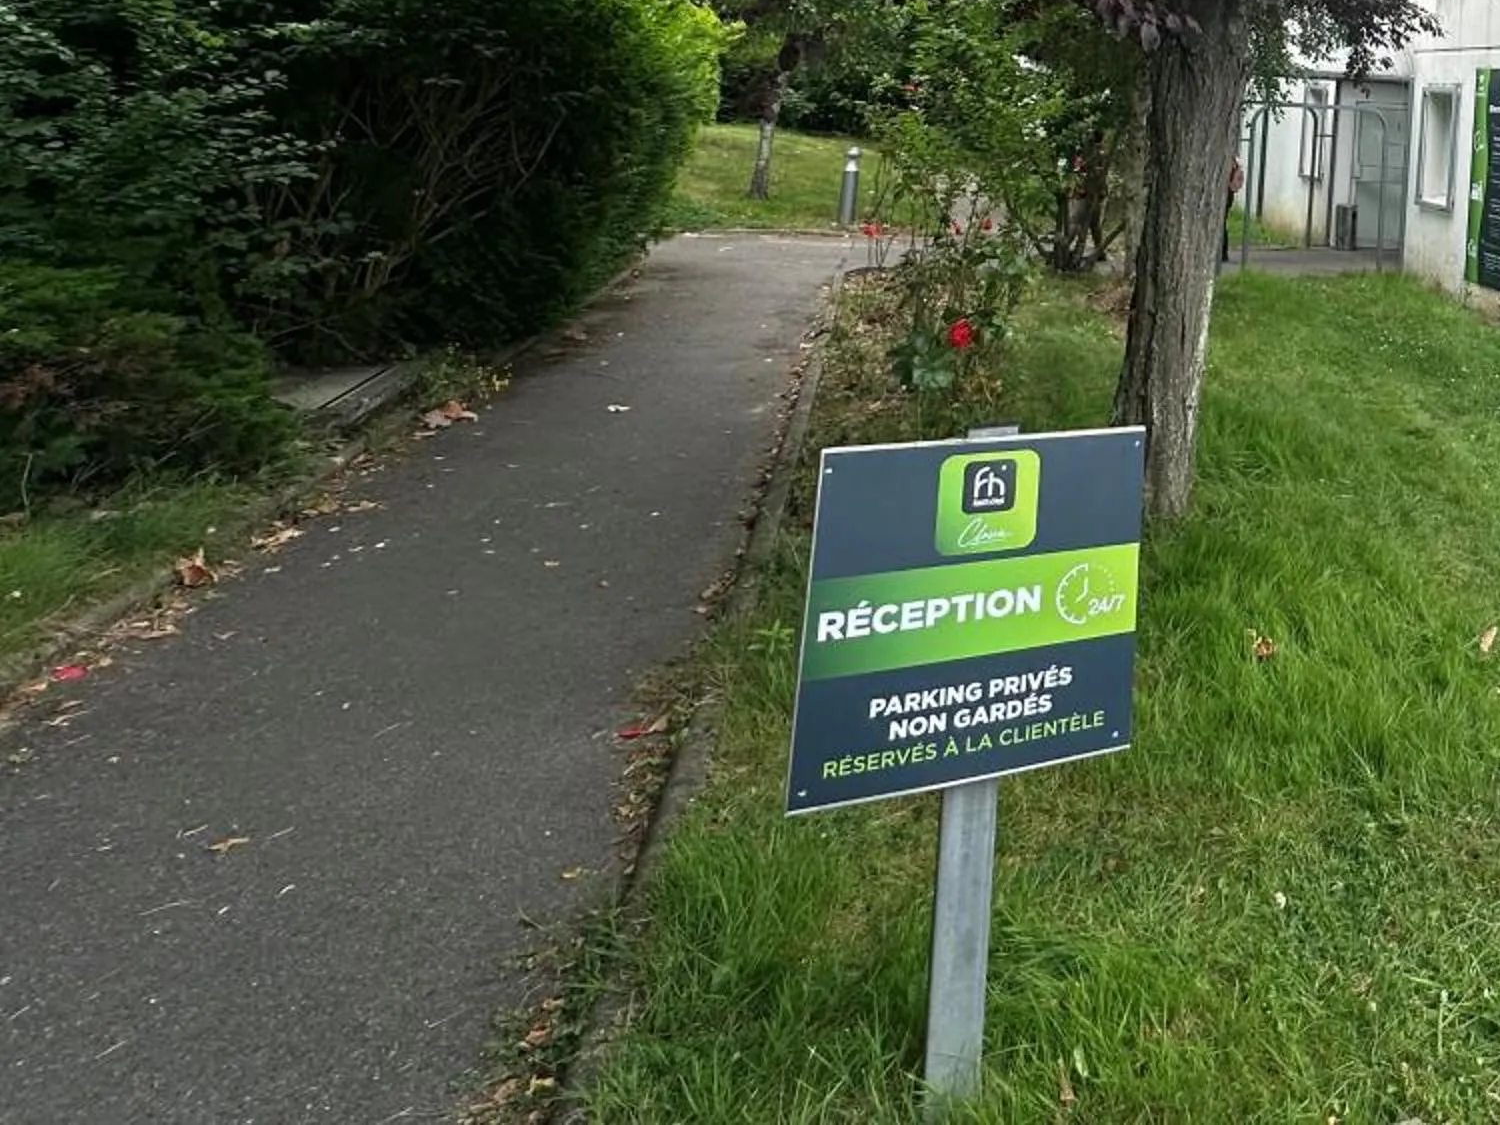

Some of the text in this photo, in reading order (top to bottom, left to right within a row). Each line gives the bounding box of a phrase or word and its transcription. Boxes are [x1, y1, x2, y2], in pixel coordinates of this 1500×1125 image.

[816, 585, 1041, 642] RÉCEPTION
[1087, 594, 1126, 616] 24/7
[869, 666, 1073, 718] PARKING PRIVÉS
[888, 693, 1053, 741] NON GARDÉS
[823, 710, 1105, 778] RÉSERVÉS À LA CLIENTÈLE
